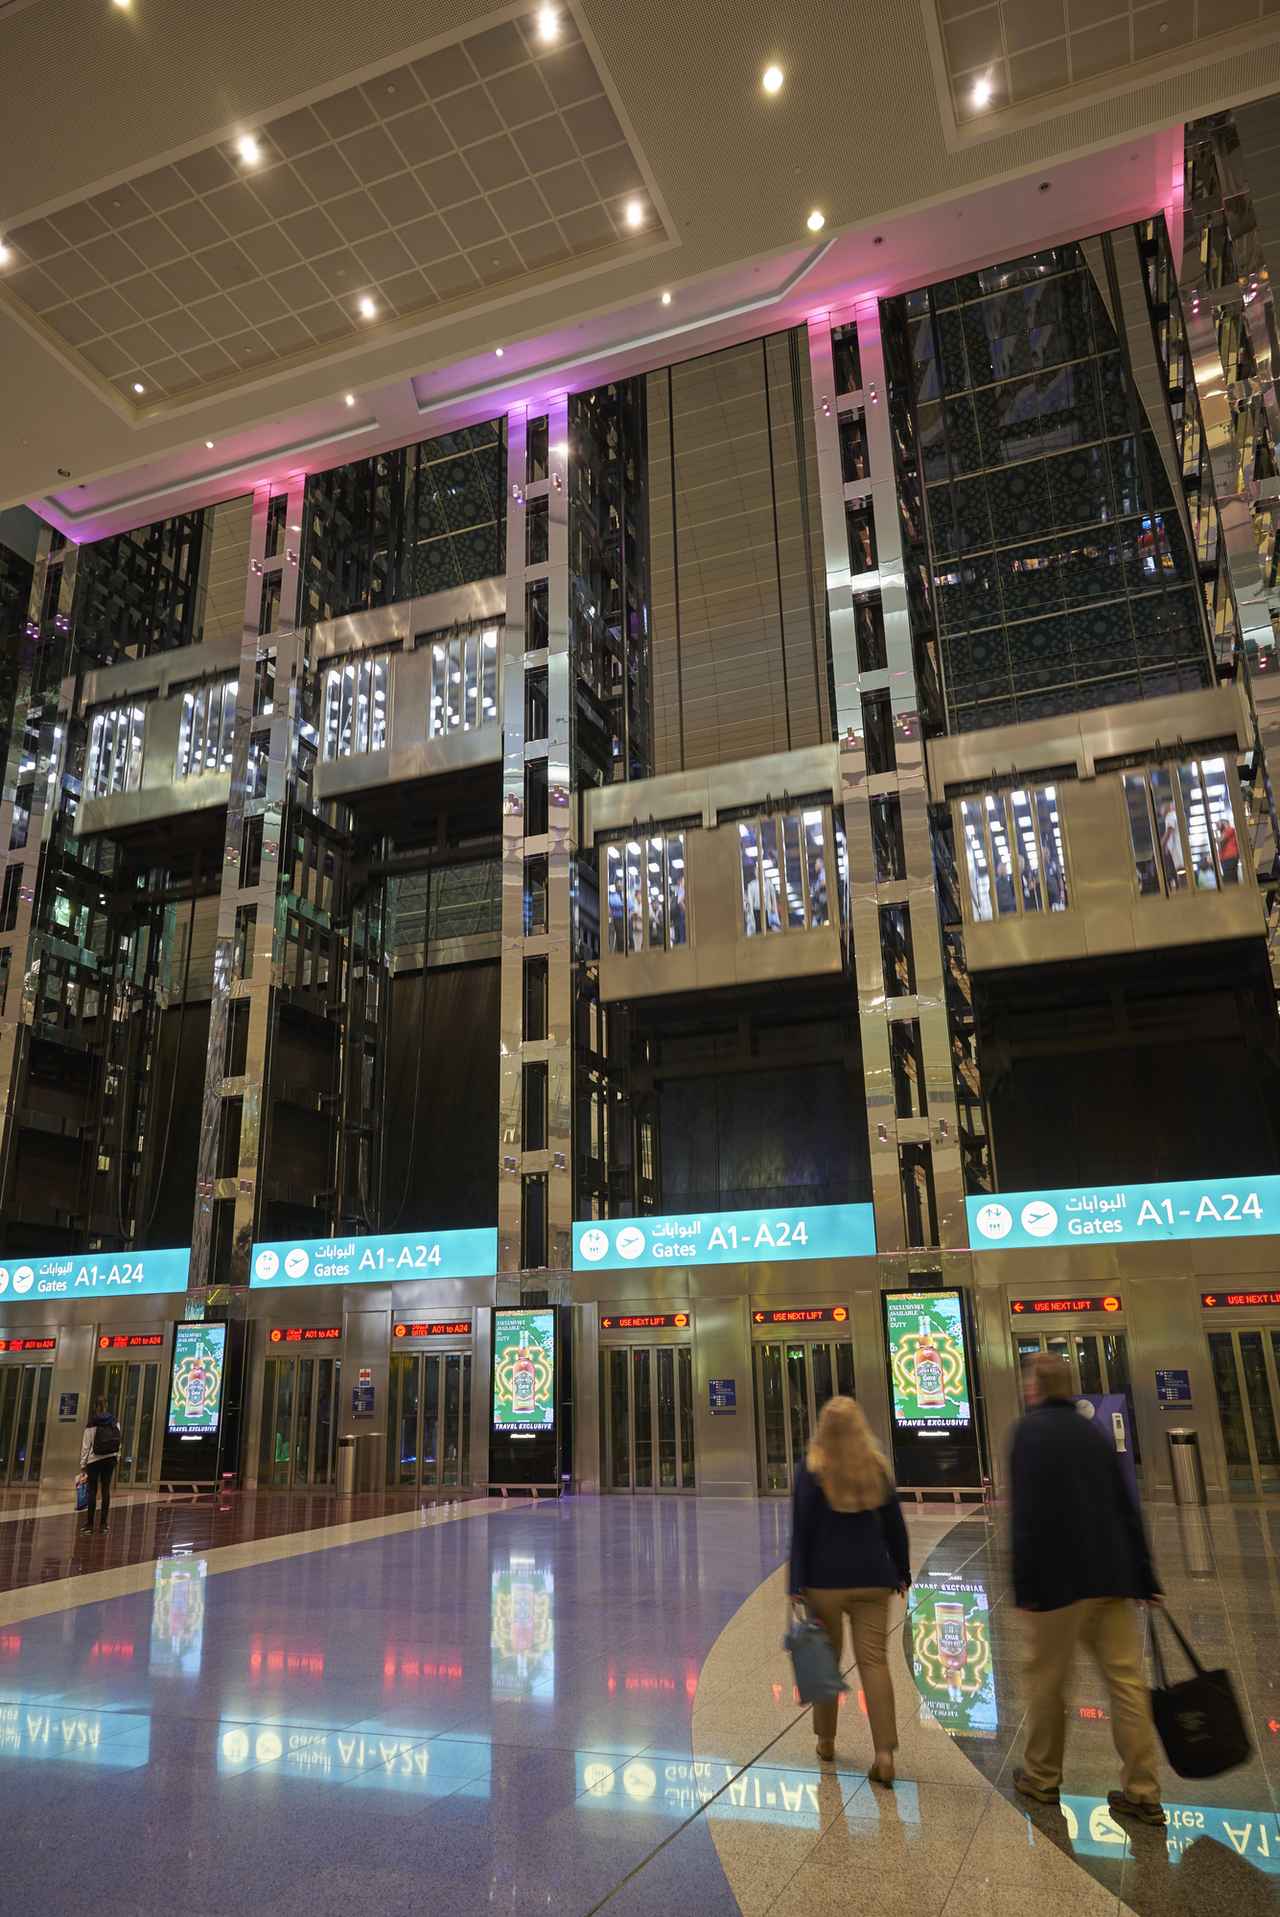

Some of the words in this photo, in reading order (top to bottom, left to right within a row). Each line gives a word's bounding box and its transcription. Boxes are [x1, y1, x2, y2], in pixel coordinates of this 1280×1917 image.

[1065, 1193, 1127, 1213] البوابات
[1067, 1218, 1123, 1236] Gates
[1136, 1192, 1263, 1226] A1-A24
[651, 1220, 701, 1239] البوابات
[652, 1242, 697, 1258] Gates
[707, 1221, 809, 1250] A1-A24
[314, 1243, 355, 1259] البوابات
[314, 1263, 350, 1277] Gates
[358, 1244, 442, 1270] A1-A24
[39, 1261, 74, 1275] البوابات
[37, 1279, 68, 1293] Gates
[74, 1263, 144, 1287] A1-A24
[1034, 1303, 1049, 1311] USE
[1050, 1302, 1071, 1311] NEXT
[1073, 1301, 1091, 1310] LIFT
[619, 1319, 632, 1327] USE
[633, 1318, 649, 1327] NEXT
[650, 1317, 664, 1326] LIFT
[773, 1313, 786, 1321] USE
[787, 1312, 806, 1320] NEXT
[807, 1311, 823, 1320] LIFT
